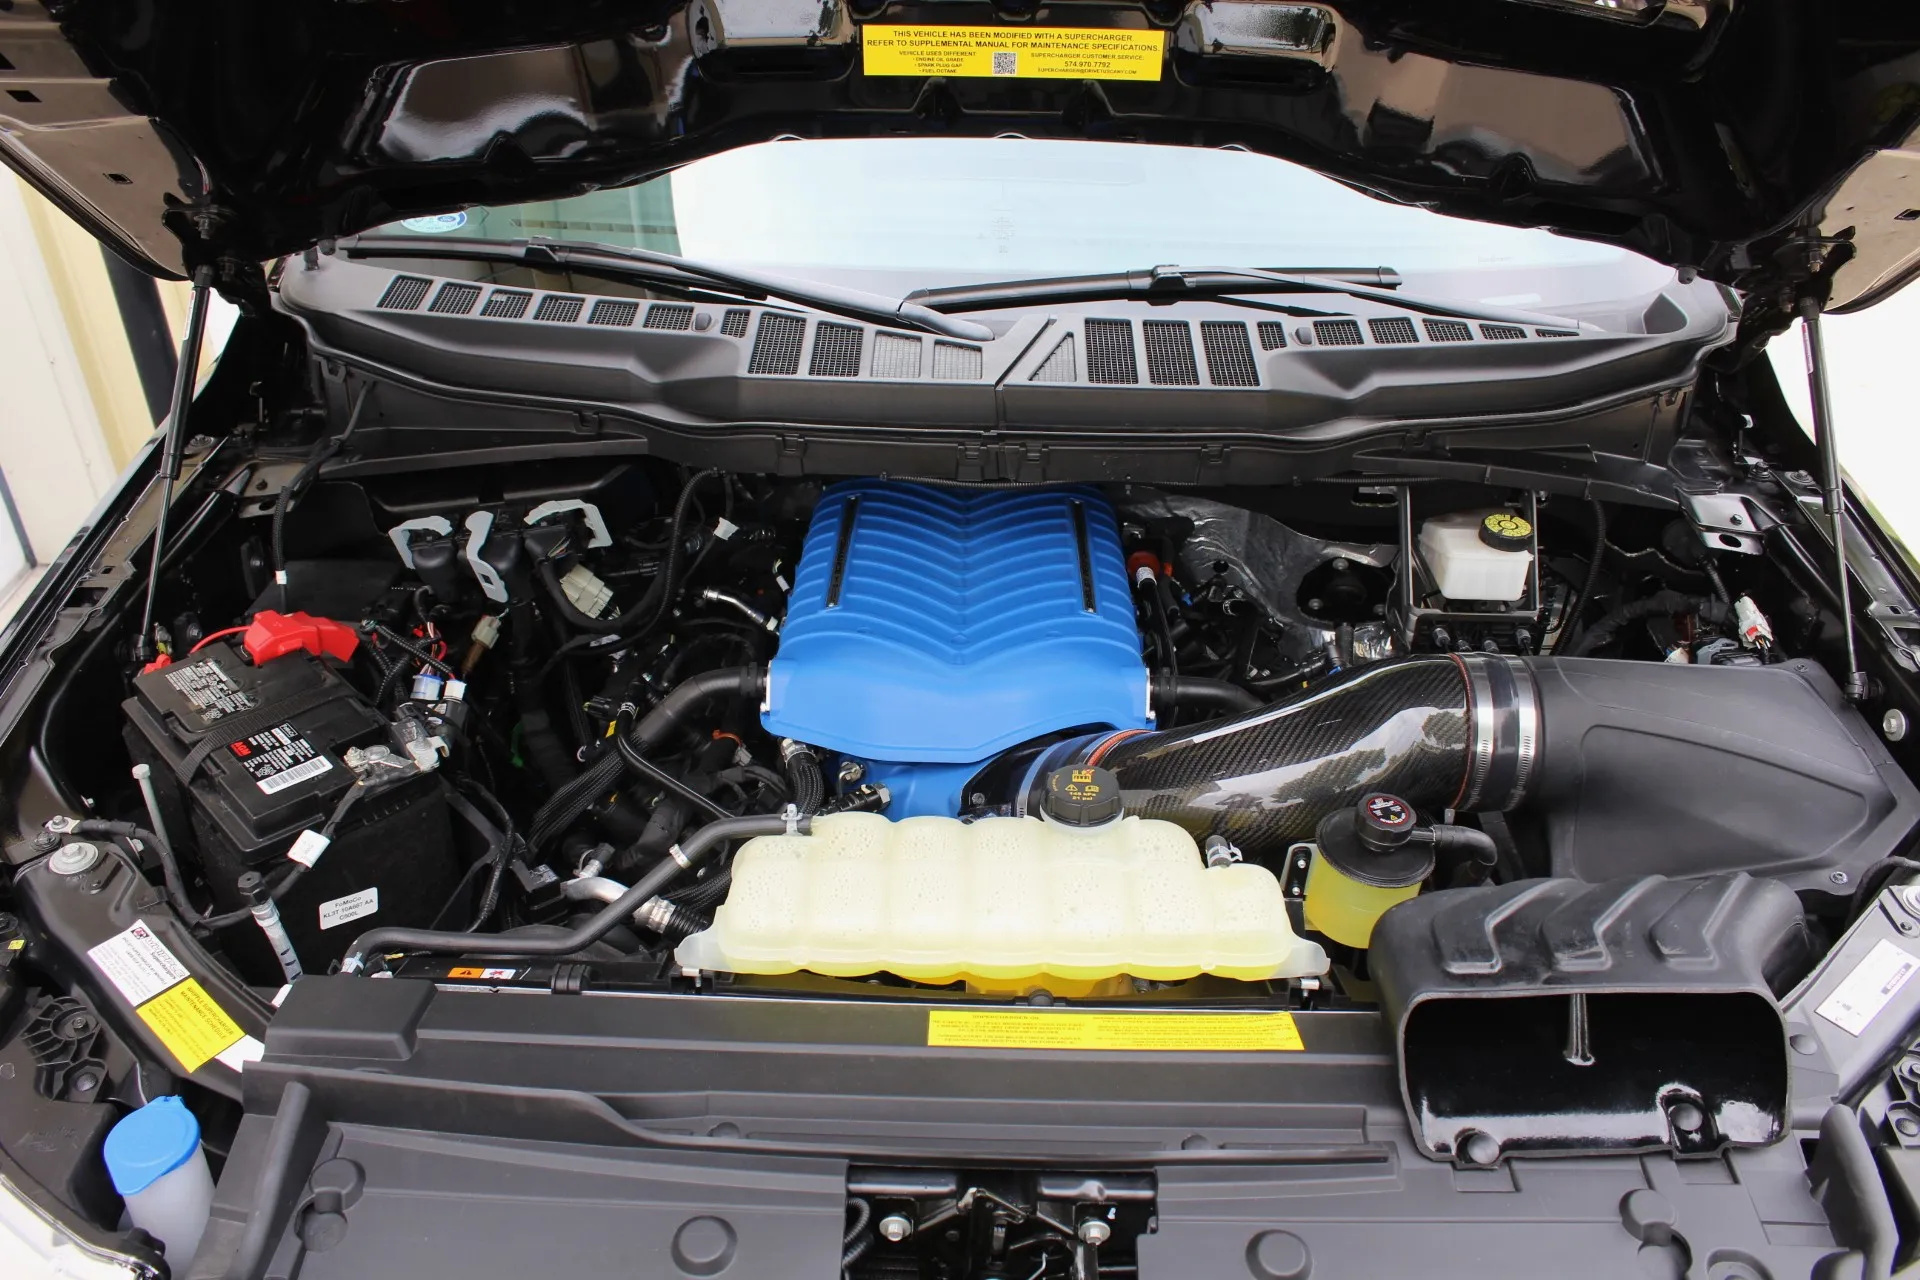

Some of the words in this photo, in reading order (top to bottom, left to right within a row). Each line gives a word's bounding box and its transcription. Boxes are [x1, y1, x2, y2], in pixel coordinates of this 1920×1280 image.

[1031, 42, 1089, 50] MAINTENANCE
[1092, 44, 1160, 52] SPECIFICATIONS.
[233, 740, 252, 756] AGM
[335, 897, 361, 908] FoMoCo
[179, 990, 207, 1018] MAINTENANCE
[204, 1017, 226, 1040] SCHEDULE
[201, 1002, 234, 1035] SUPERCHARGER
